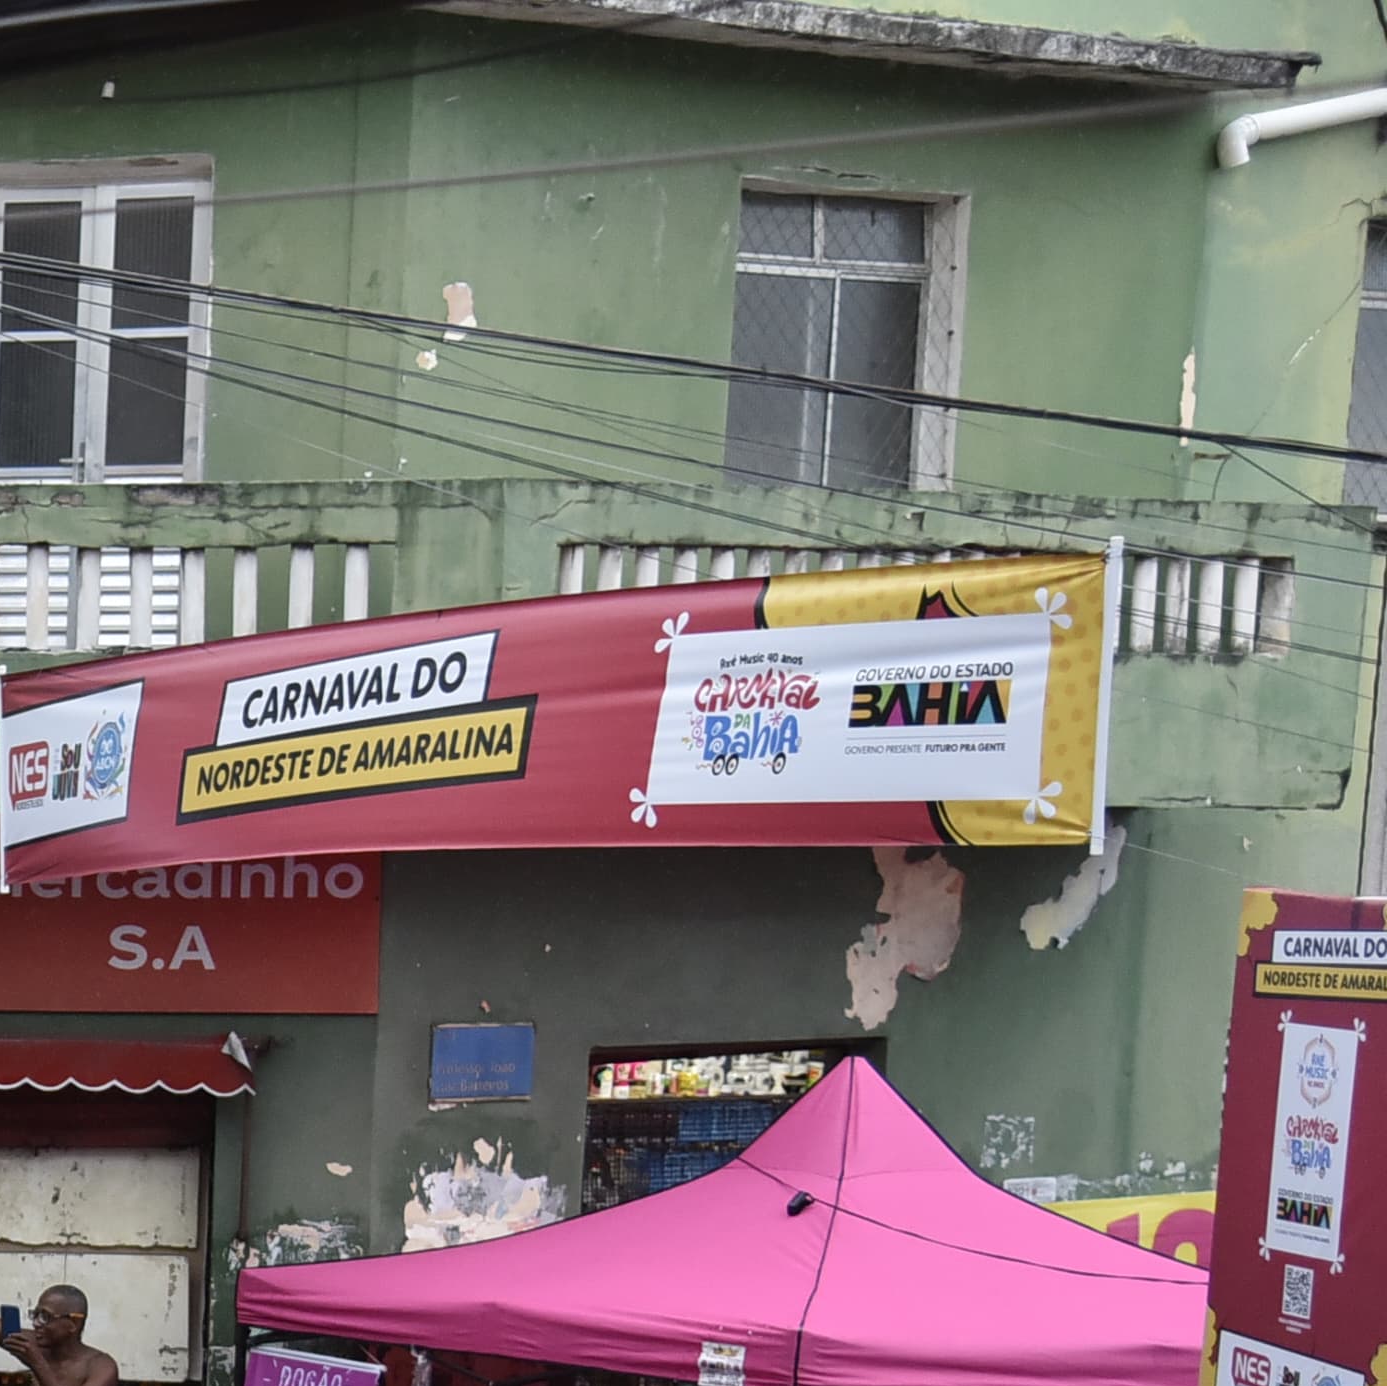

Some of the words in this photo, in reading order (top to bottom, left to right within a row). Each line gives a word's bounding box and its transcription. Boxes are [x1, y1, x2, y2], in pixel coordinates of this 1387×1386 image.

[781, 654, 804, 666] anos
[855, 665, 925, 682] GOVERNO
[929, 665, 951, 680] DO
[955, 661, 1014, 678] ESTADO
[242, 663, 401, 729] CARNAVAL
[411, 651, 467, 699] DO
[848, 678, 1013, 729] BAHIA
[197, 749, 315, 796] NORDESTE
[317, 744, 351, 777] DE
[353, 723, 514, 773] AMARALINA
[844, 744, 884, 755] GOVERNO
[925, 743, 957, 753] FUTURO
[959, 743, 977, 752] PRA
[978, 742, 1006, 752] GENTE
[12, 747, 47, 795] NES
[107, 925, 216, 971] S.A
[1284, 937, 1359, 958] CARNAVAL
[1364, 938, 1387, 958] DO
[1263, 970, 1321, 988] NORDESTE
[1323, 973, 1339, 989] DE
[1234, 1351, 1269, 1386] NES
